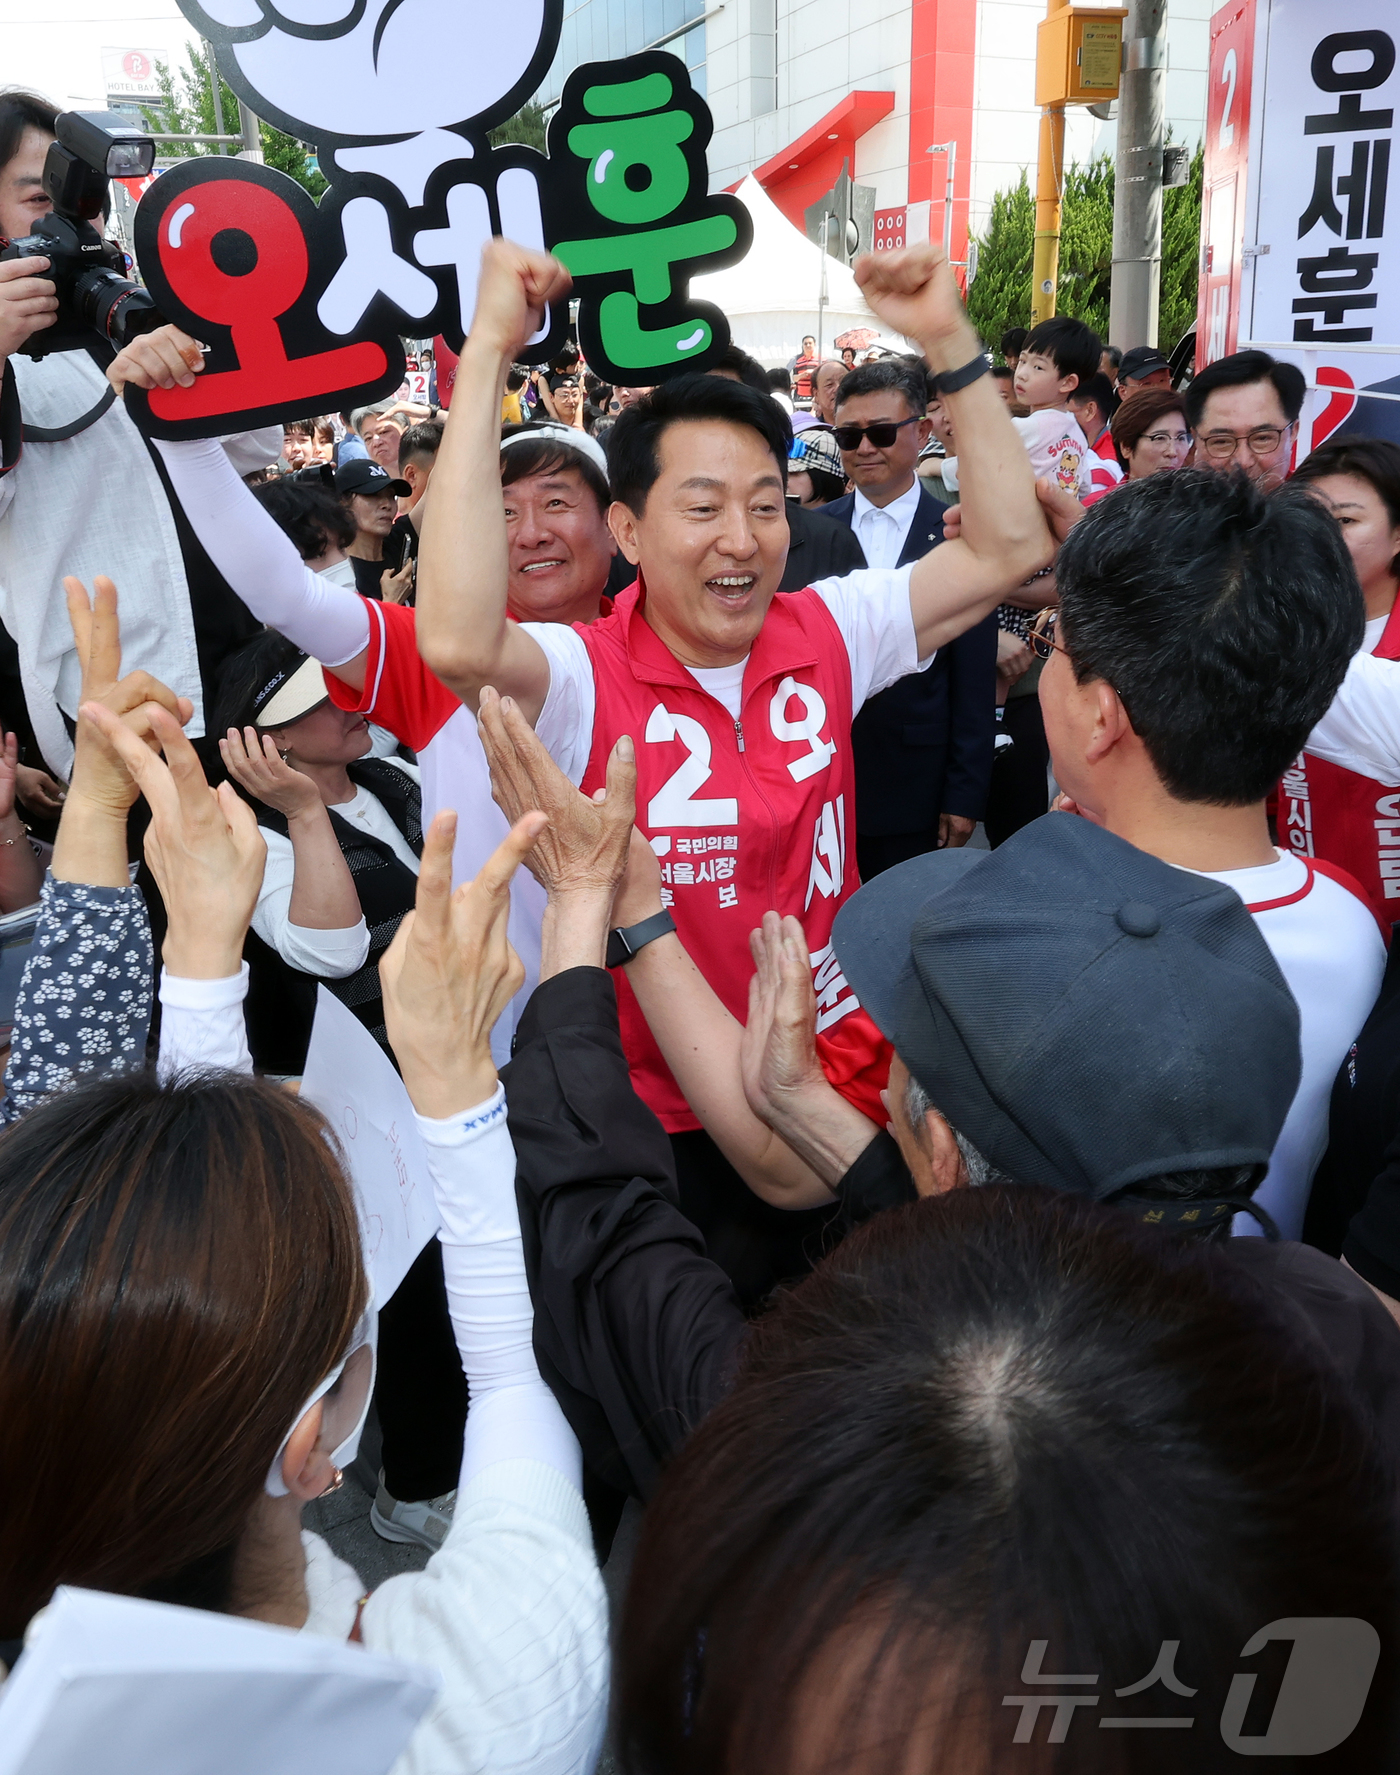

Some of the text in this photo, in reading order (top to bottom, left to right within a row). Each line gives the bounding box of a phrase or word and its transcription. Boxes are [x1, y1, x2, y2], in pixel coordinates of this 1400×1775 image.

[107, 82, 135, 91] HOTEL
[138, 83, 154, 92] BAY
[1219, 48, 1237, 151] 2
[1292, 29, 1396, 341] 오세훈
[81, 244, 102, 252] Canon
[148, 73, 737, 421] 오세훈
[414, 376, 426, 393] 2
[645, 702, 738, 828] 2
[676, 835, 738, 855] 국민의힘
